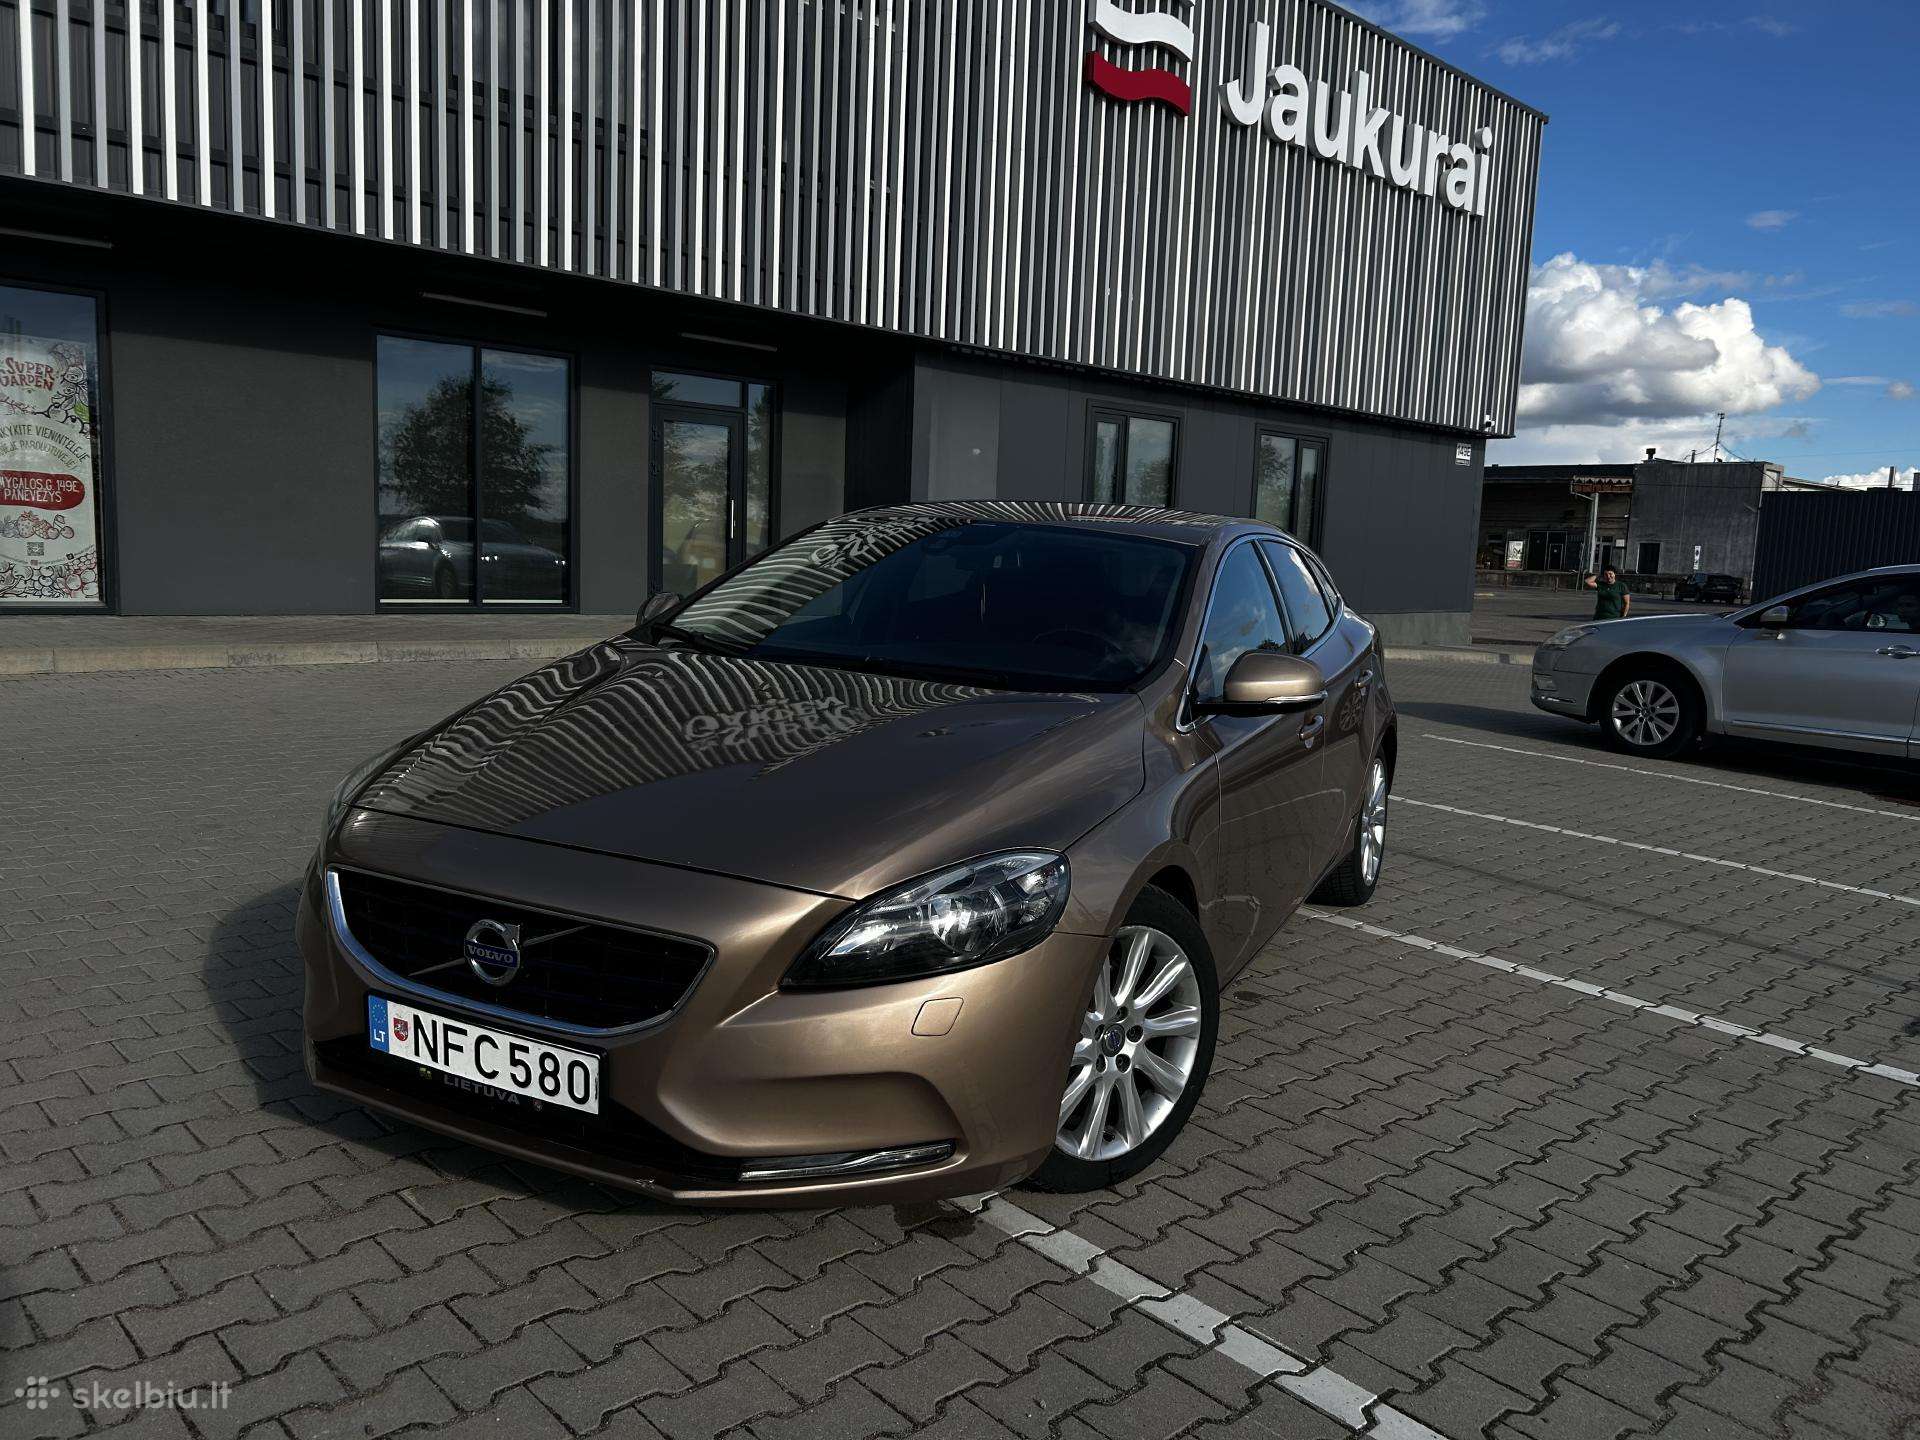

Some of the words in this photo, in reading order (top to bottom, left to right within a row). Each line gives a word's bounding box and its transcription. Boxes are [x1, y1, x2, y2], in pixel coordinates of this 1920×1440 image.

[1218, 21, 1493, 217] Jaukurai
[5, 357, 55, 381] SUPER
[56, 479, 80, 493] 149E
[467, 944, 514, 964] VOLVO
[374, 1028, 386, 1043] LT
[443, 1074, 520, 1105] LIETUVA
